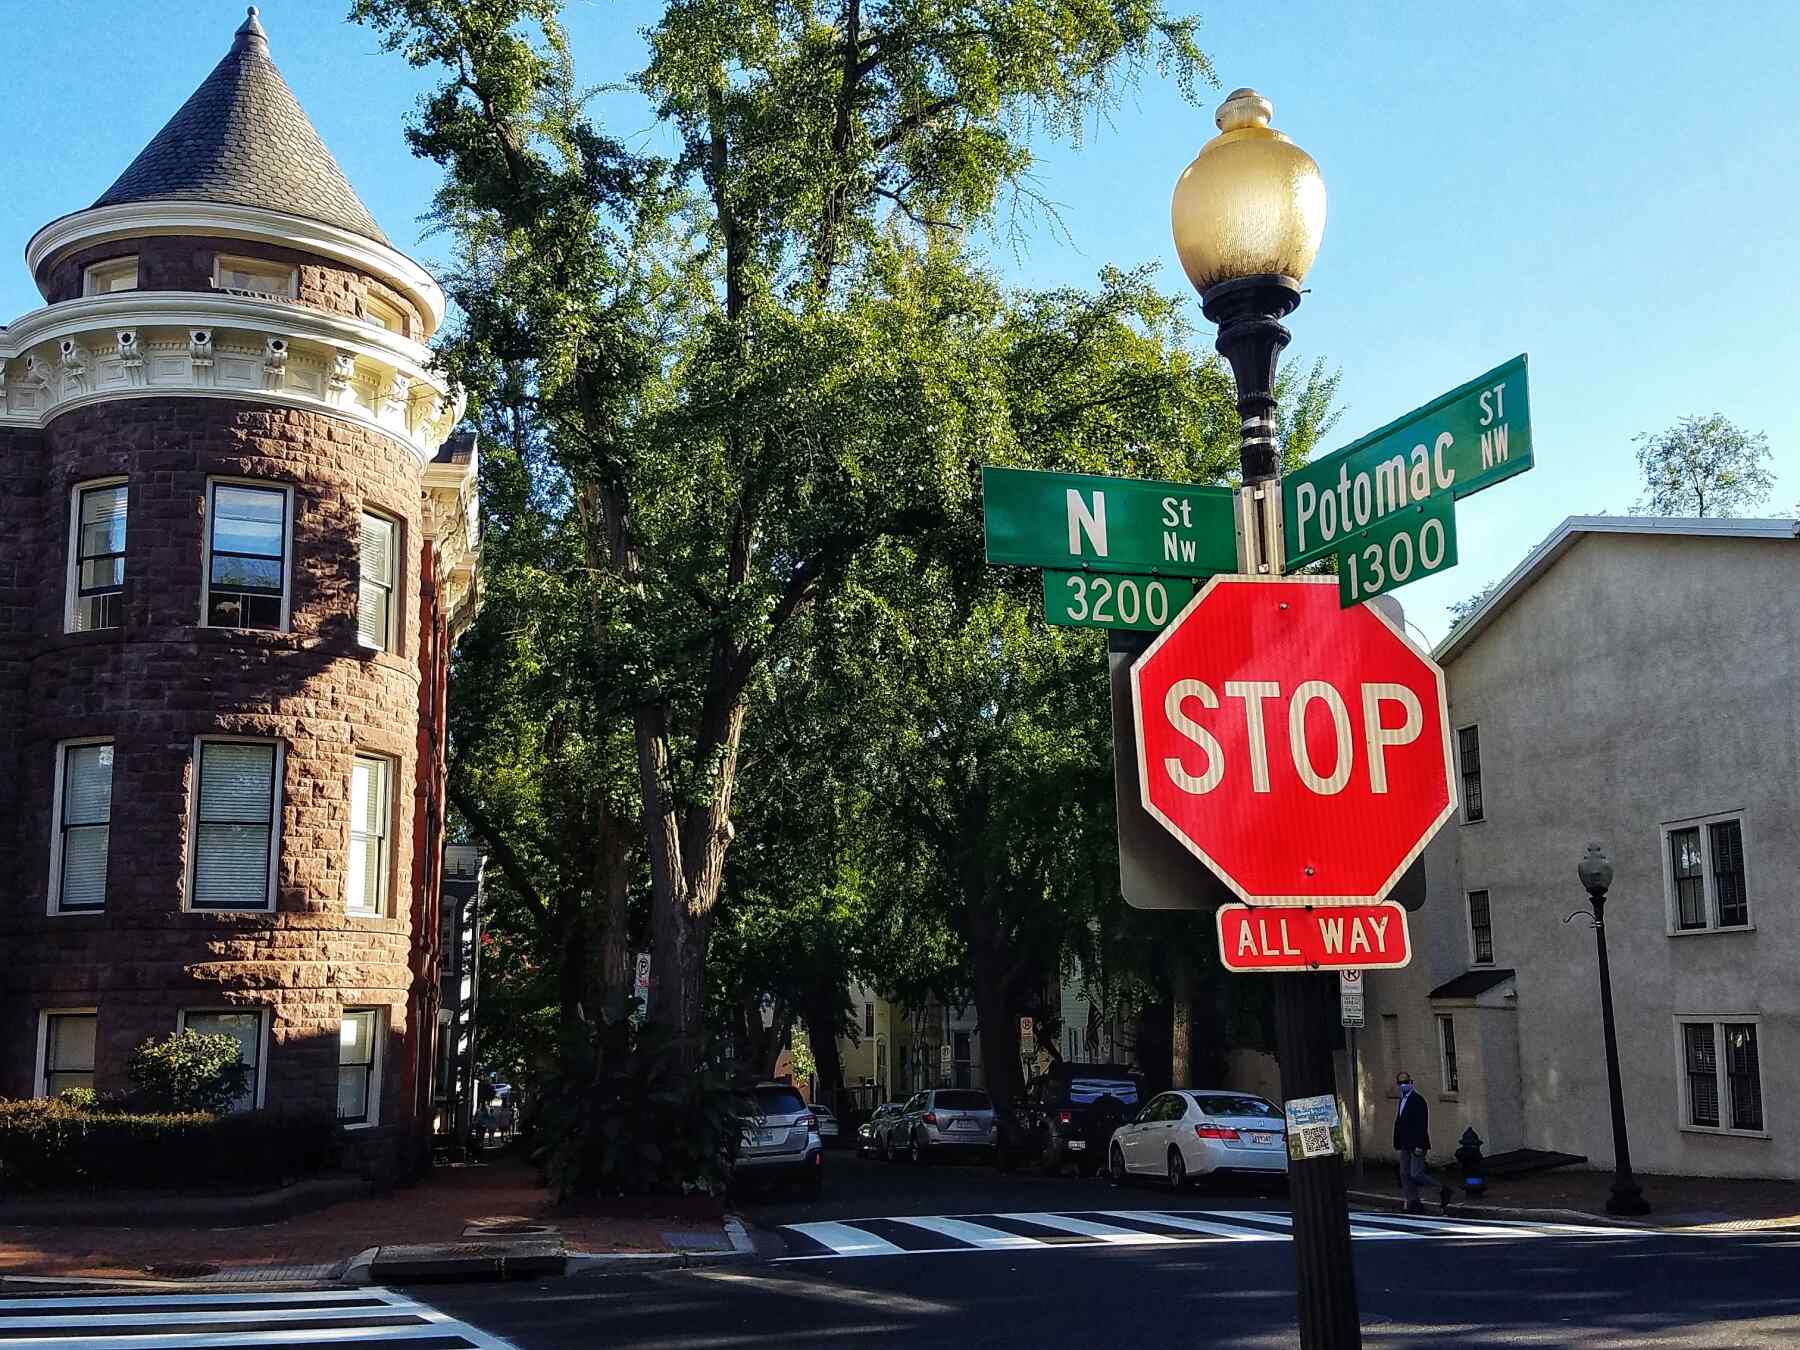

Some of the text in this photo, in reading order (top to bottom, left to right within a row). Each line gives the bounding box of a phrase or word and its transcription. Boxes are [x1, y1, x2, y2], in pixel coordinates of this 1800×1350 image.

[1479, 383, 1506, 426] ST
[1480, 423, 1509, 470] NW
[1161, 497, 1193, 528] St
[1296, 431, 1456, 553] Potomac
[1066, 488, 1108, 557] N
[1347, 518, 1445, 600] 1300
[1066, 576, 1168, 626] 3200
[1164, 678, 1424, 796] STOP
[1237, 913, 1389, 957] ALL WAY
